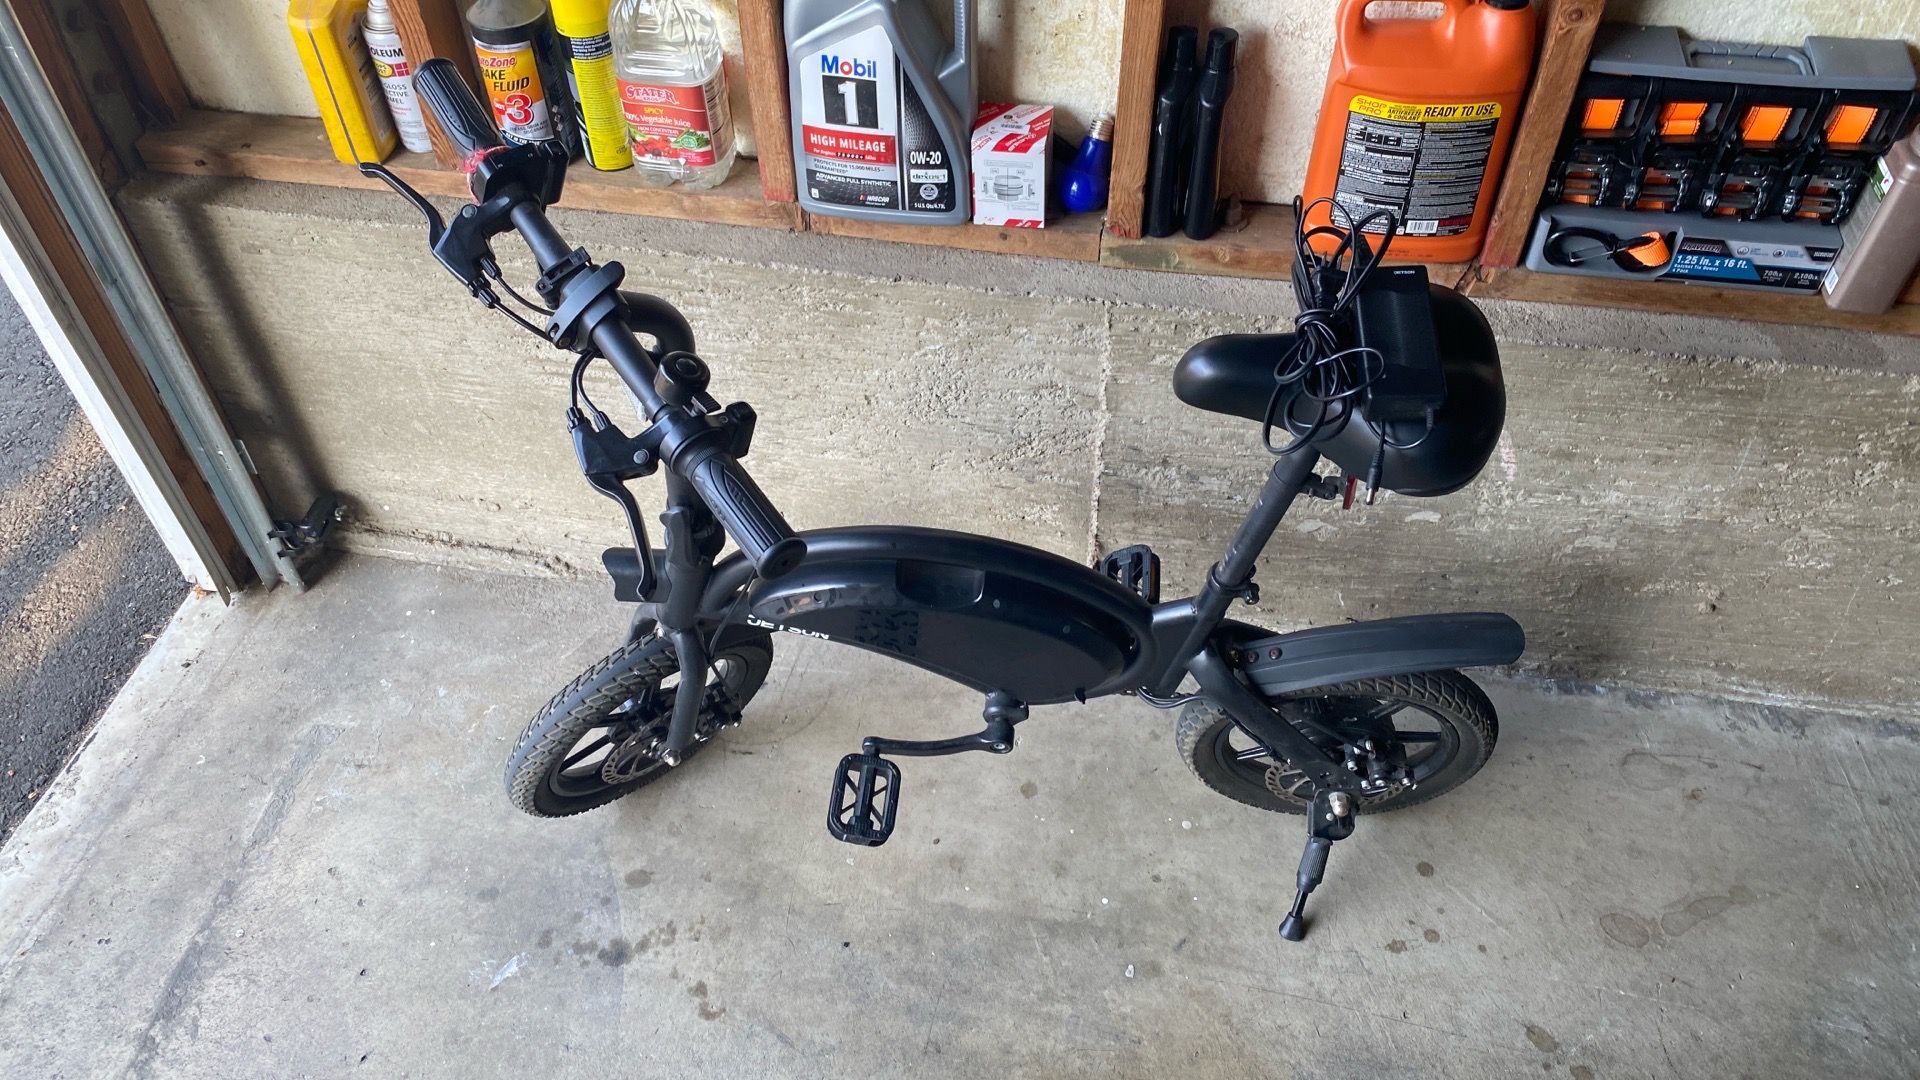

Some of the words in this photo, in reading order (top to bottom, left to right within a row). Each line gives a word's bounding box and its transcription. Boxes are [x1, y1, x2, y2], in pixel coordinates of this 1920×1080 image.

[821, 55, 877, 78] Mobil
[493, 76, 530, 92] FLUID
[626, 86, 677, 103] STATER
[505, 93, 534, 125] 3
[838, 81, 860, 126] 1
[1356, 97, 1387, 109] SHOP
[1423, 106, 1459, 117] READY
[1460, 105, 1475, 117] TO
[1475, 103, 1497, 115] USE
[643, 107, 664, 115] SPICY
[1358, 105, 1382, 116] PRO
[1387, 109, 1422, 117] ANTIFREEZE
[640, 114, 673, 126] Vegetable
[673, 117, 691, 128] Juice
[810, 133, 836, 147] HIGH
[839, 137, 887, 153] MILEAGE
[910, 151, 942, 165] 0W-20
[815, 172, 846, 183] ADVANCED
[846, 177, 861, 185] FULL
[860, 179, 892, 187] SYNTHETIC
[866, 195, 890, 203] NASCAR
[1676, 255, 1699, 265] 1.25
[1699, 256, 1712, 266] in.
[1713, 259, 1721, 267] x
[1723, 258, 1736, 268] 16
[1736, 259, 1749, 269] ft.
